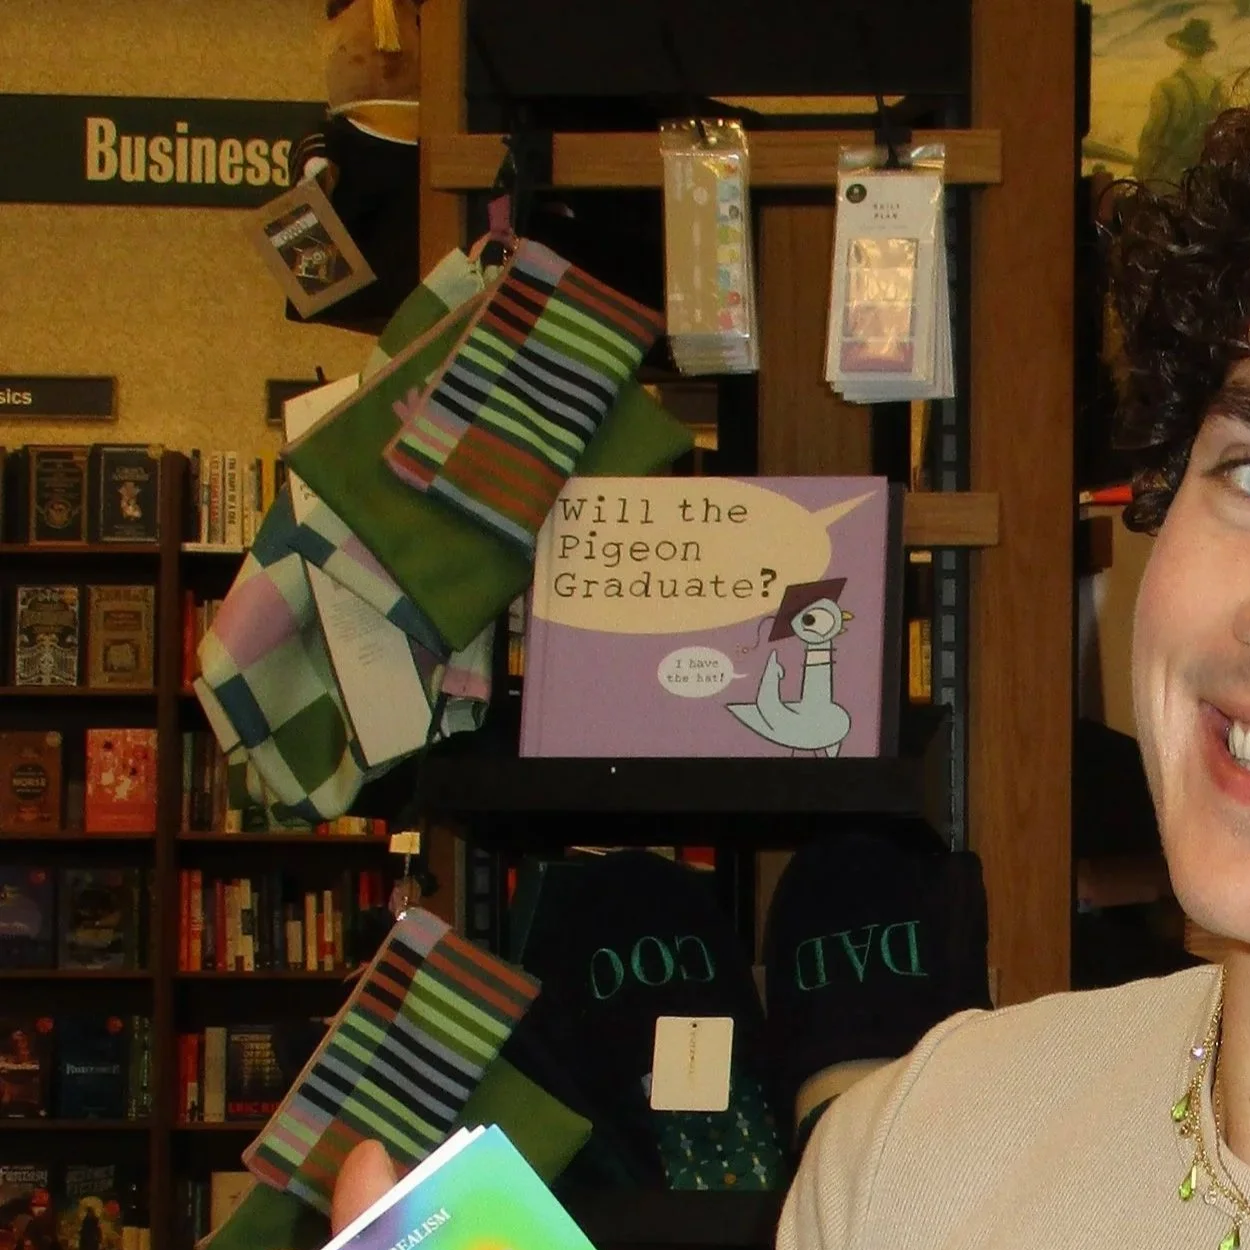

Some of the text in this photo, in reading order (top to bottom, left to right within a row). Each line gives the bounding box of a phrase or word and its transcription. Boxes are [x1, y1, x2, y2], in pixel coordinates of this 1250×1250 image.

[85, 117, 292, 187] Business
[558, 495, 748, 525] Will the
[557, 531, 702, 568] Pigeon
[553, 567, 778, 600] Graduate?
[666, 672, 724, 683] the hat!
[675, 659, 719, 669] I have
[796, 920, 929, 992] DAD
